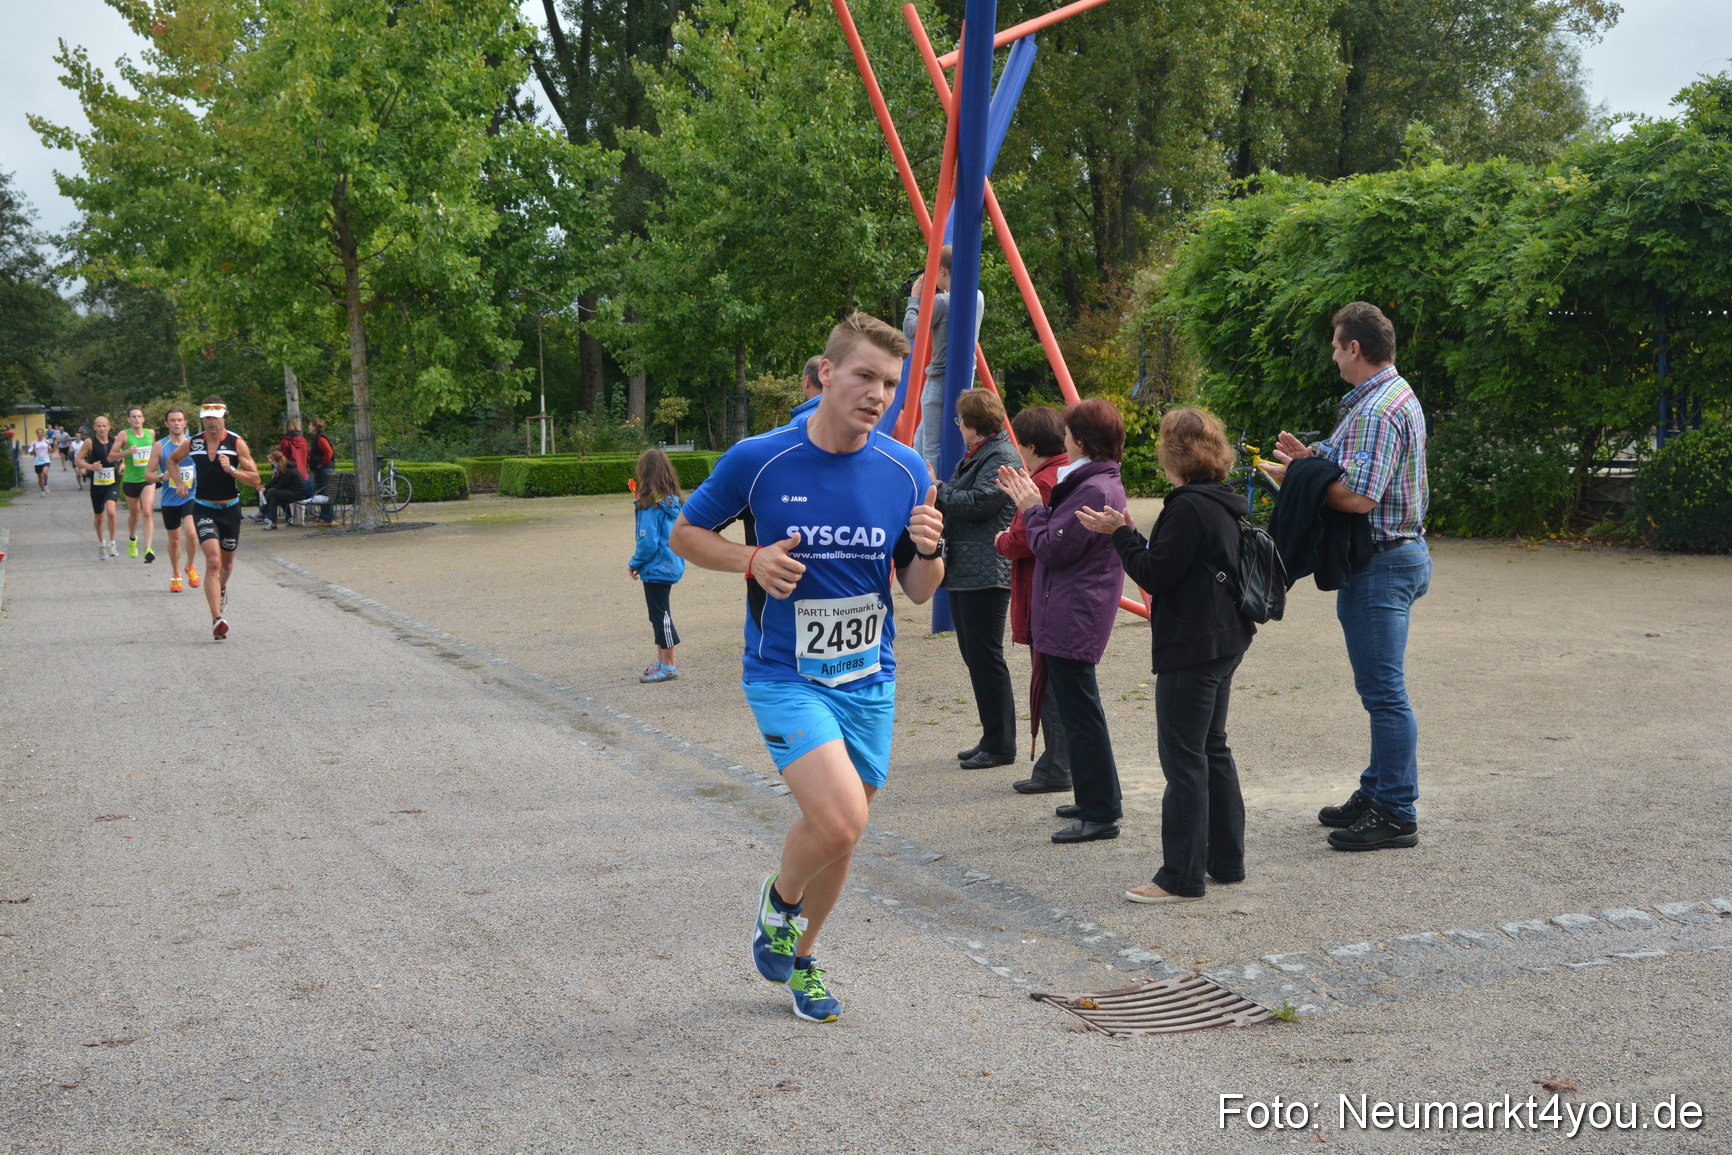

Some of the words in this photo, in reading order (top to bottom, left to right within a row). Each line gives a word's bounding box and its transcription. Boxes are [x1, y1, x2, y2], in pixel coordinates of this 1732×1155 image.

[786, 525, 886, 547] SYSCAD
[797, 608, 830, 617] PARTL
[832, 603, 875, 617] Neumarkt
[807, 614, 878, 654] 2430
[821, 657, 865, 676] Andreas
